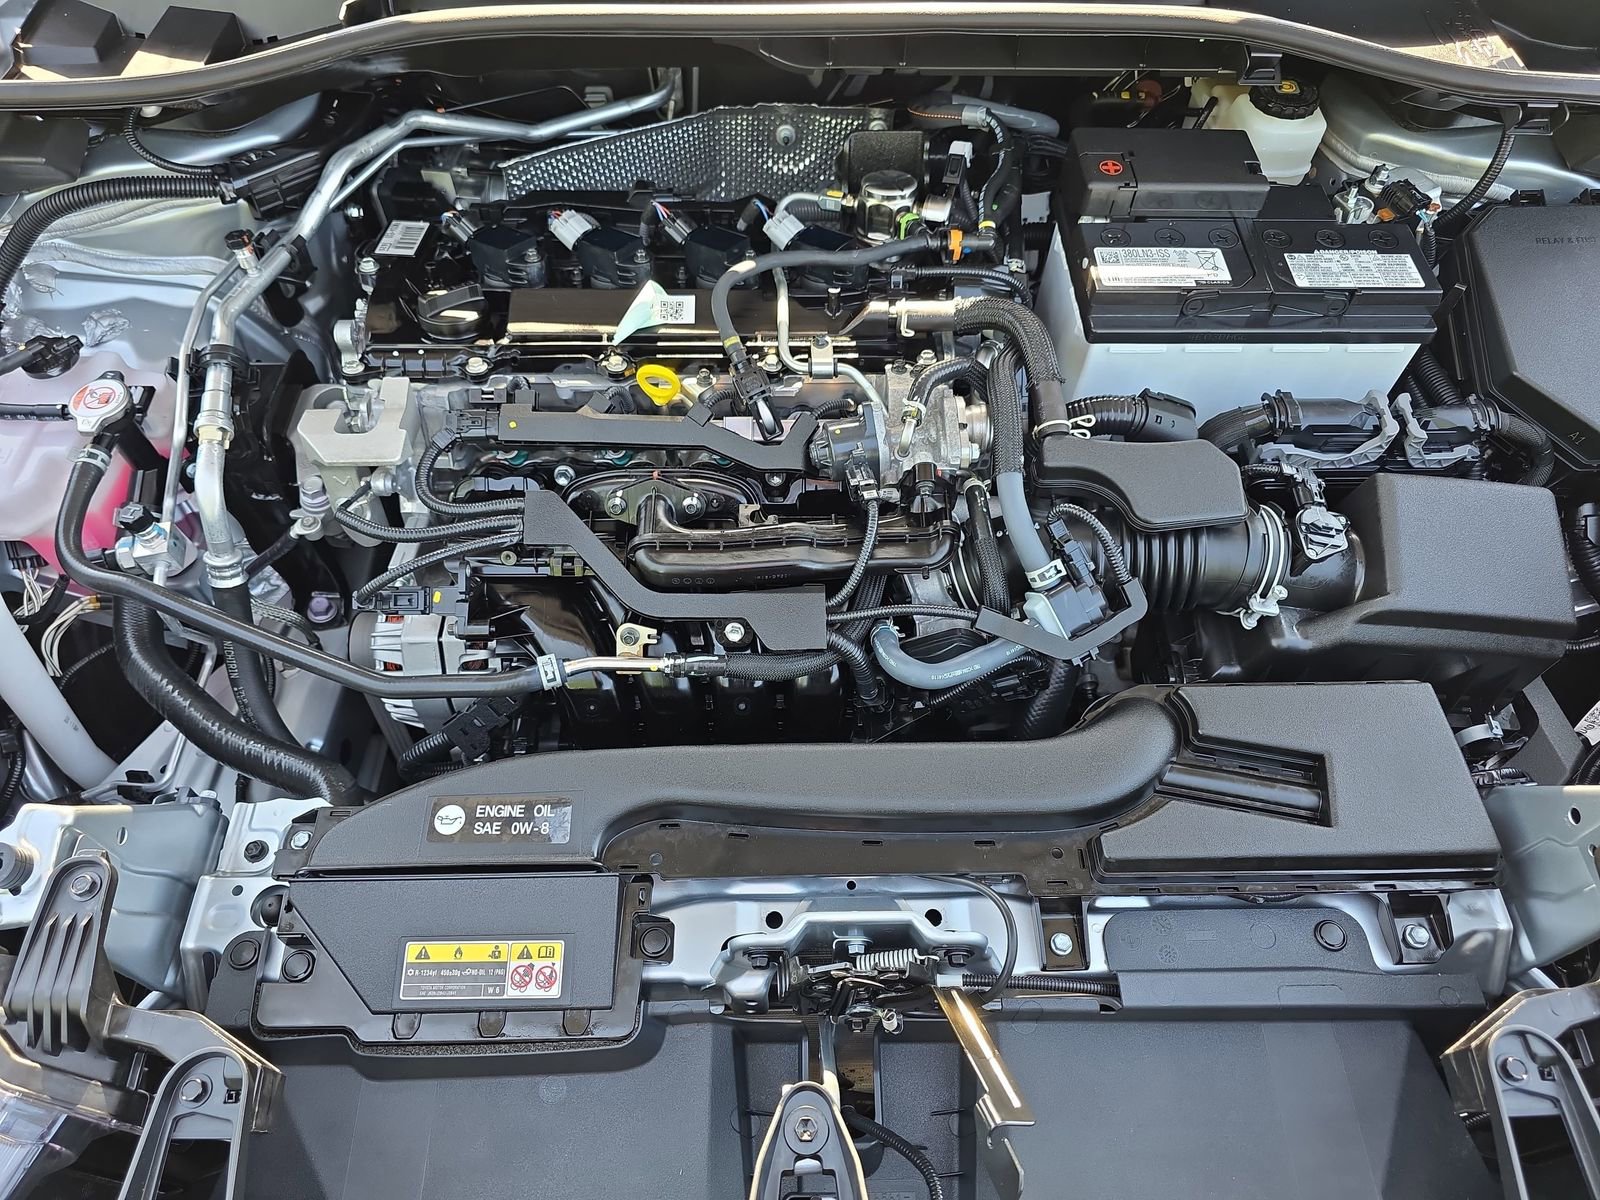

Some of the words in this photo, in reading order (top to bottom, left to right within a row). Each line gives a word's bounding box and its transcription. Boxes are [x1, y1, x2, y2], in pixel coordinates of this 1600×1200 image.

[1122, 249, 1171, 258] 380LN3-ISS
[223, 640, 240, 679] NICHIRIN
[475, 804, 526, 818] ENGINE
[533, 804, 556, 817] OIL
[473, 821, 501, 835] SAE
[511, 821, 550, 835] 0W-8
[487, 986, 495, 994] W
[495, 986, 500, 994] 6
